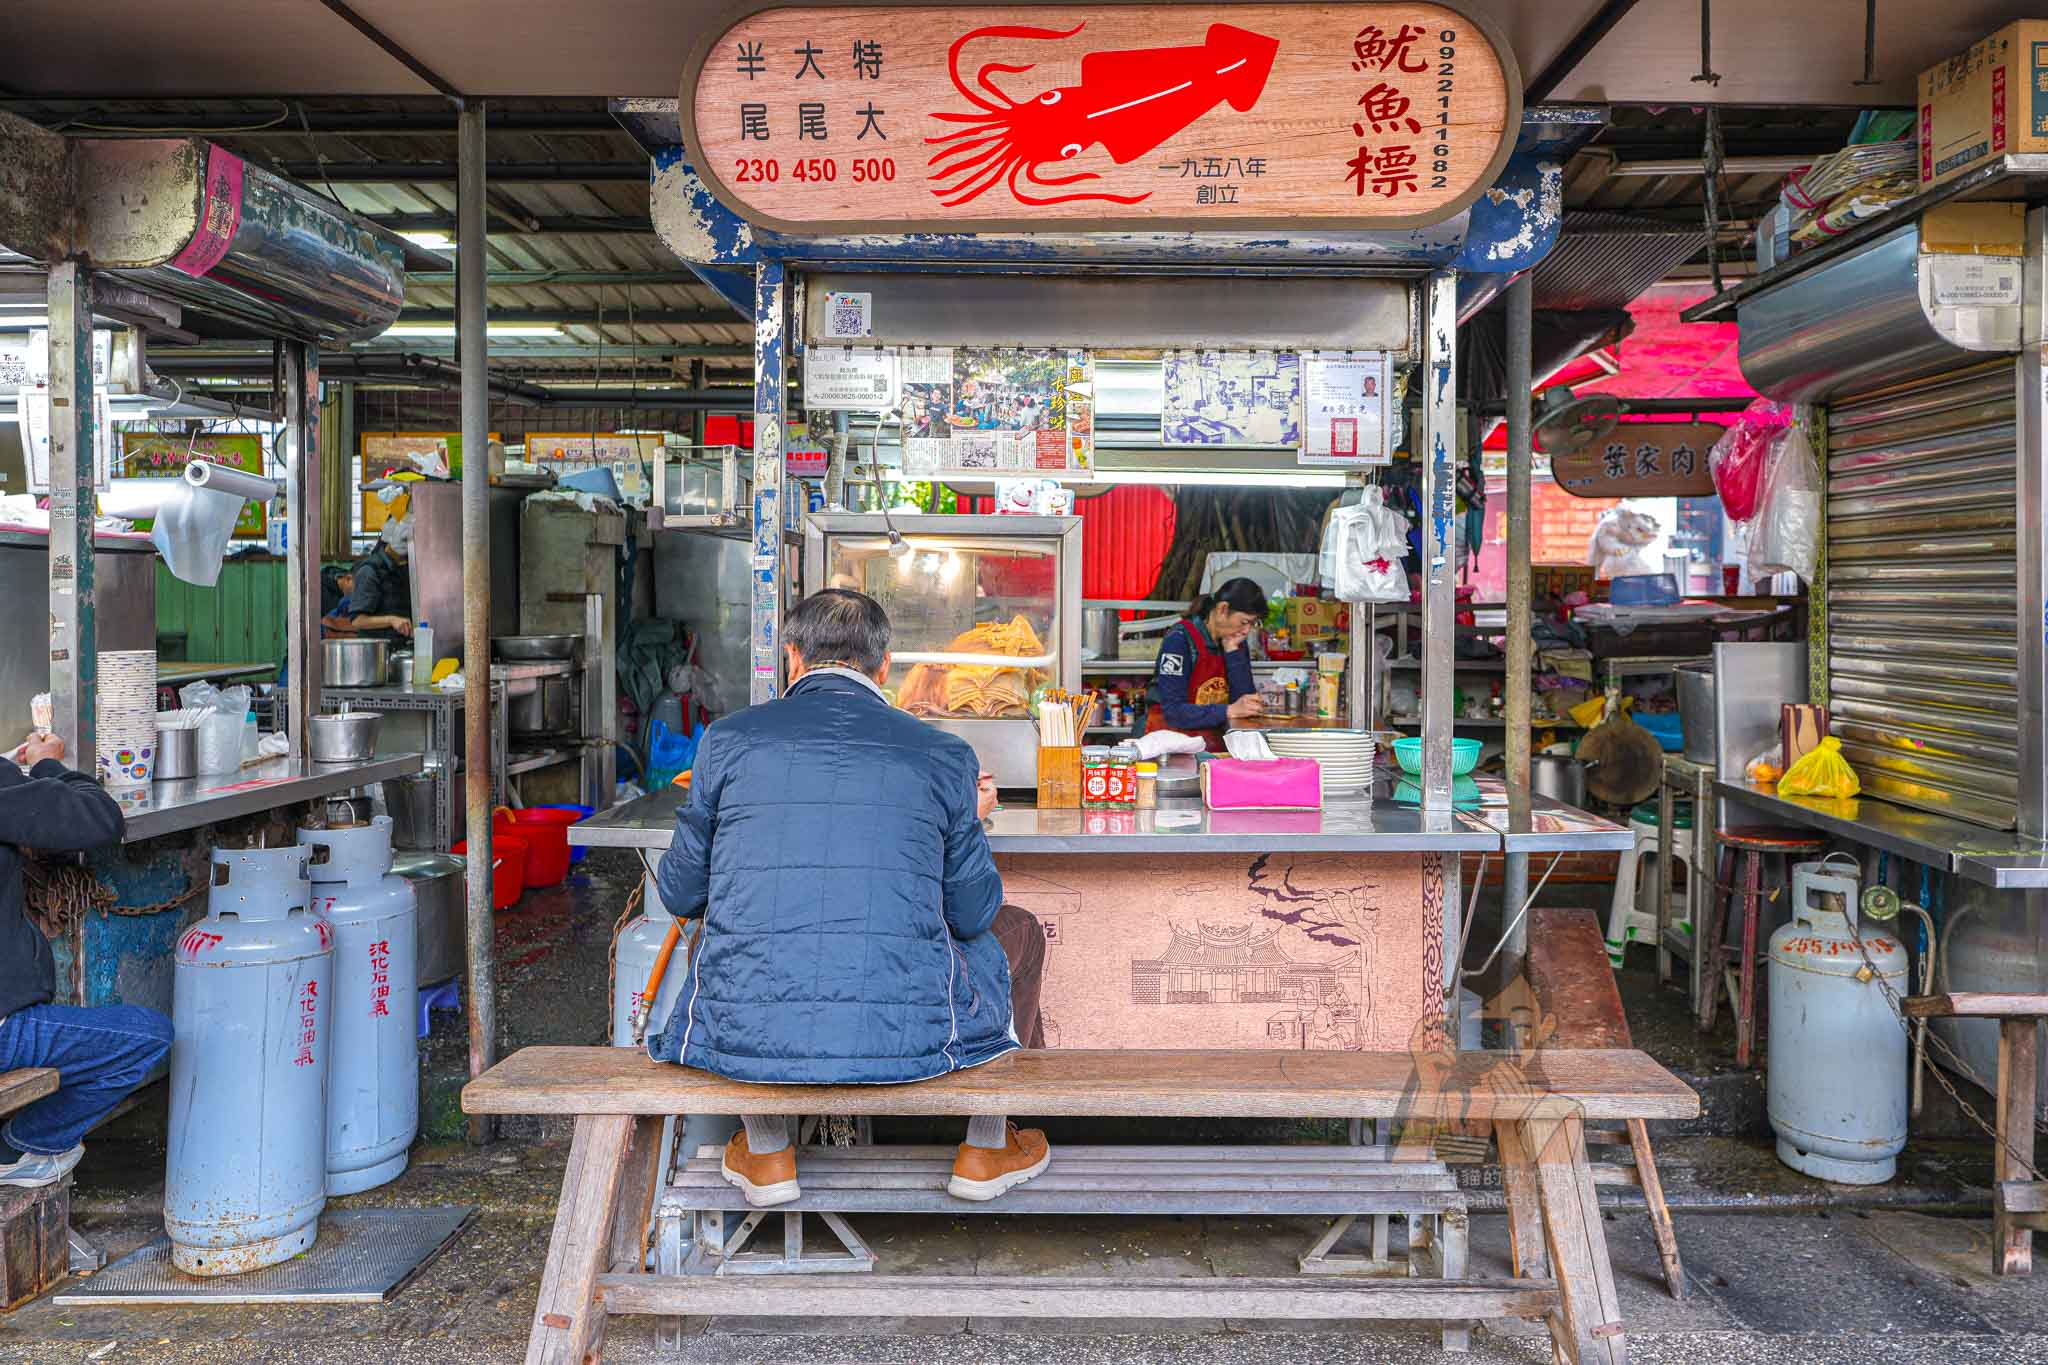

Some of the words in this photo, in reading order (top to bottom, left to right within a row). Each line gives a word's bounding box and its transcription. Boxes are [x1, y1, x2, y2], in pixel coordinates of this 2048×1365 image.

[1345, 24, 1429, 198] 魷魚標
[1431, 29, 1456, 188] 0922111682
[735, 158, 779, 182] 230
[792, 158, 837, 182] 450
[852, 157, 896, 182] 500
[1158, 157, 1267, 178] 一九五八年
[1196, 184, 1239, 204] 創立
[368, 939, 391, 1018] 液化石油氣
[294, 979, 318, 1067] 液化石油氣
